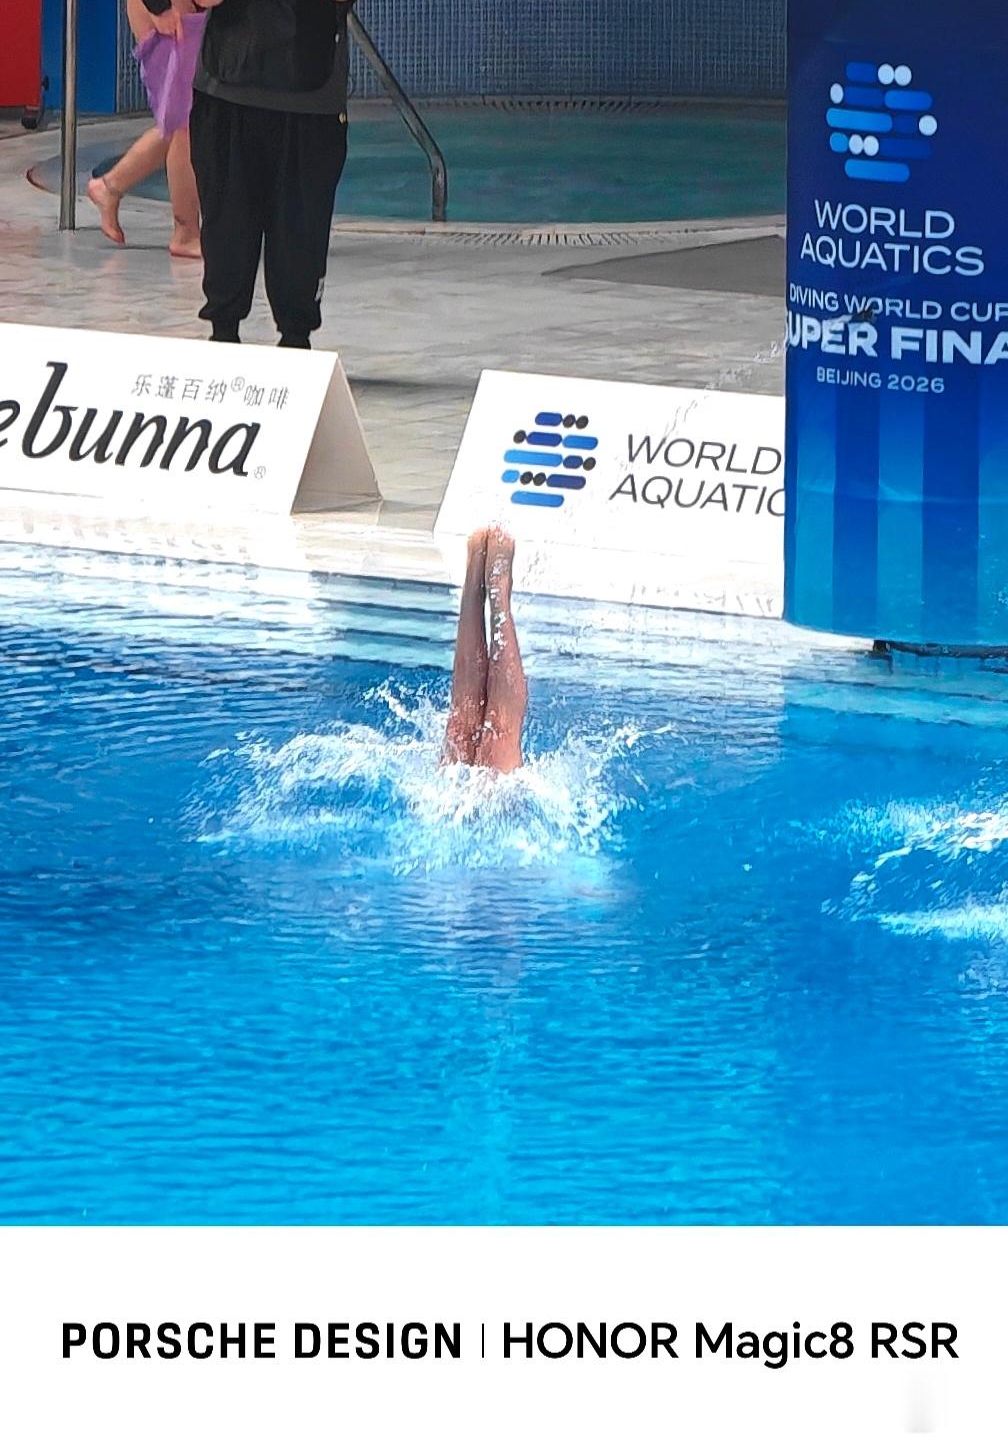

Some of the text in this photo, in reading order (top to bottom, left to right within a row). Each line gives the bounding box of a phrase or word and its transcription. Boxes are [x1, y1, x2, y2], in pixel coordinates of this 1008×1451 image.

[814, 199, 955, 239] WORLD
[800, 232, 985, 276] AQUATICS
[789, 282, 839, 312] DIVING
[844, 293, 942, 320] WORLD
[786, 310, 878, 357] UPER
[816, 366, 945, 394] BEIJING 2026
[628, 433, 782, 476] WORLD
